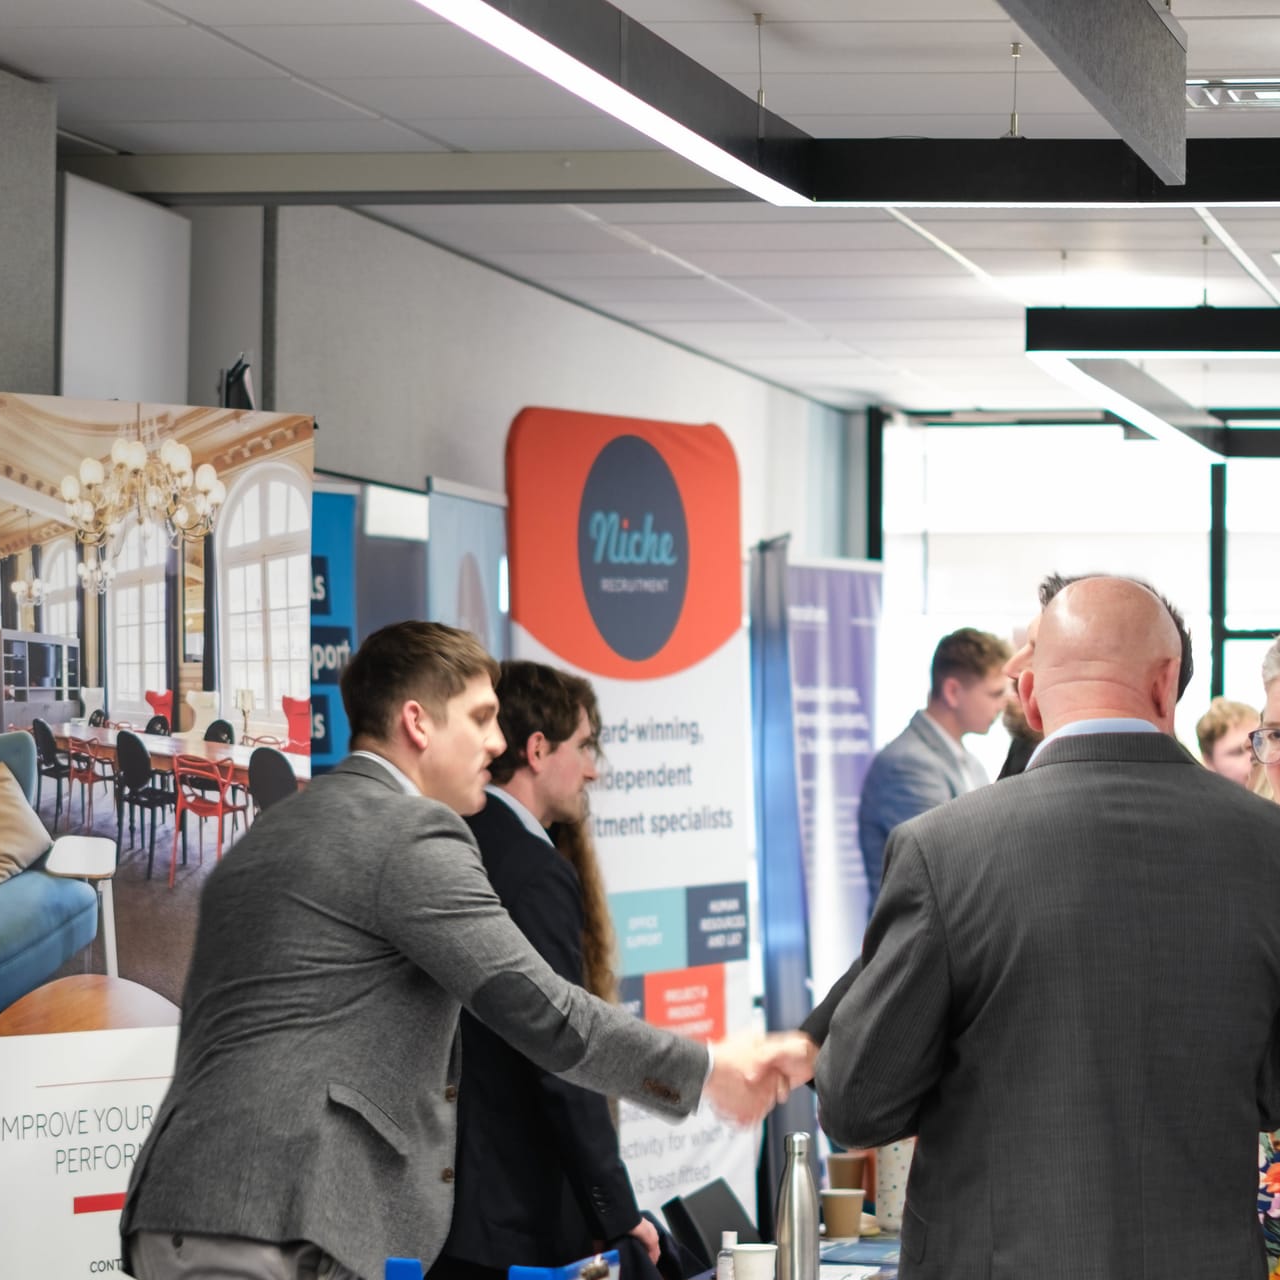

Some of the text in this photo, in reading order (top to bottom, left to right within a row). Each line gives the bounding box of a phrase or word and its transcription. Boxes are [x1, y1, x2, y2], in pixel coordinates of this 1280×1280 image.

[589, 509, 678, 566] Niche
[650, 805, 734, 837] specialists
[94, 1104, 154, 1133] YOUR
[55, 1143, 143, 1175] PERFOR
